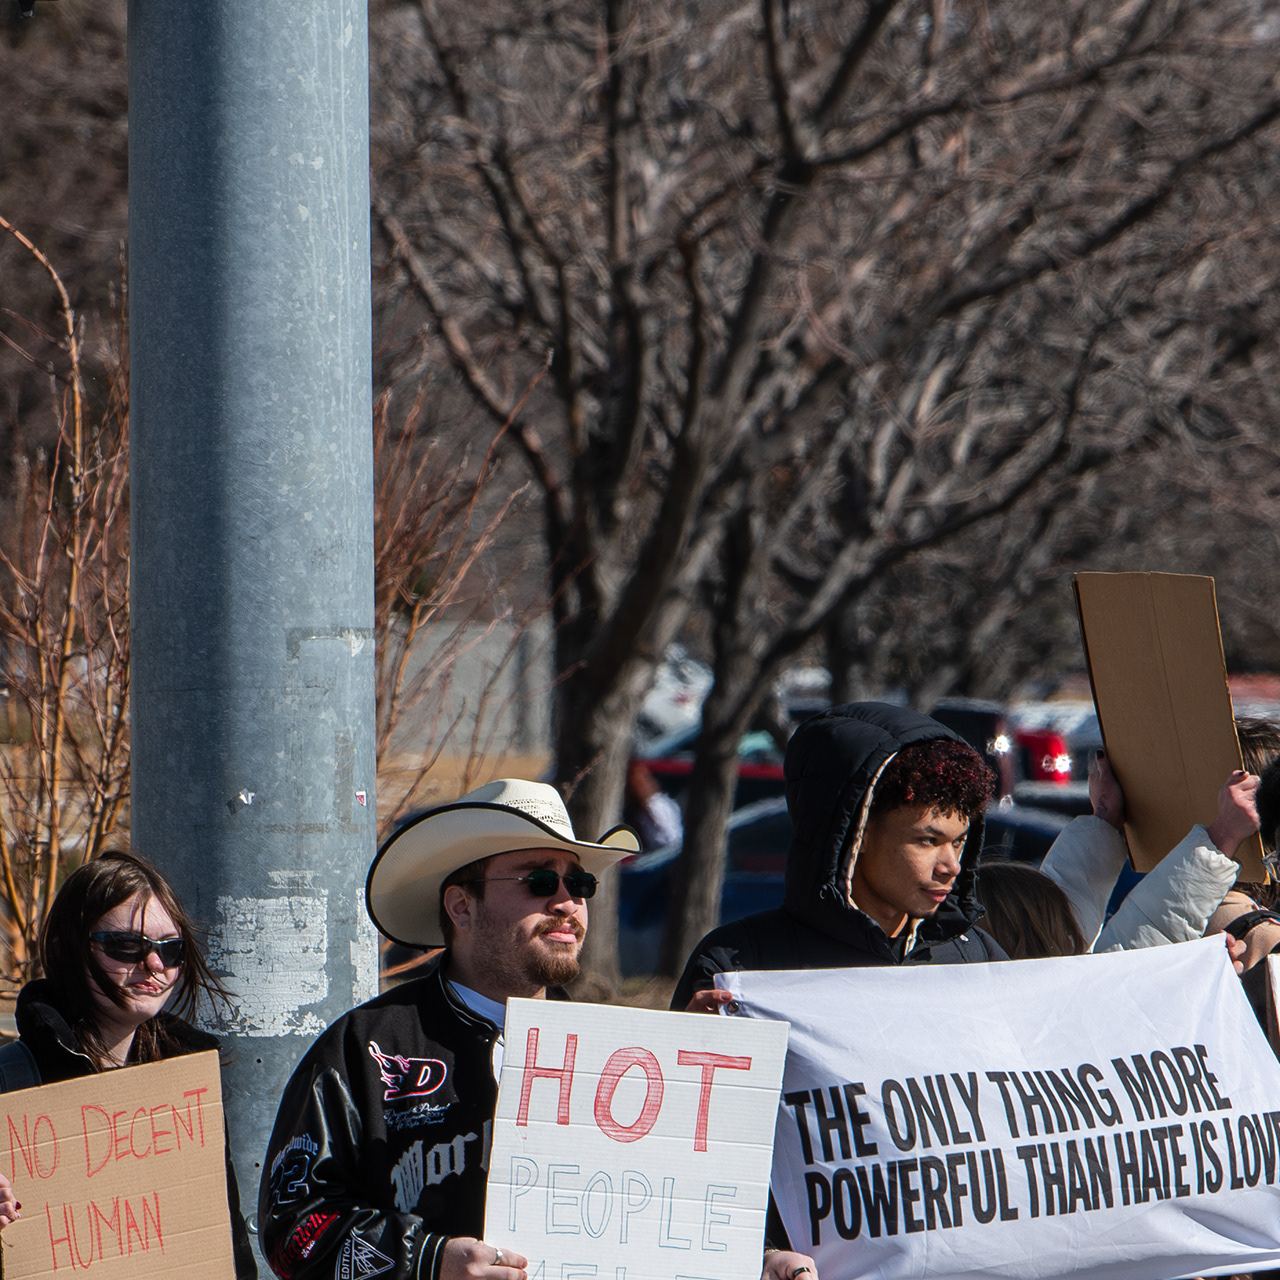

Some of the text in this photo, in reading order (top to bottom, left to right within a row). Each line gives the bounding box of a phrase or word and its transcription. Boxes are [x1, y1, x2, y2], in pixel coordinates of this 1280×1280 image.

[7, 1088, 209, 1180] NO DECENT
[516, 1028, 752, 1152] HOT
[784, 1045, 1233, 1165] THE ONLY THING MORE
[45, 1190, 166, 1272] HUMAN
[507, 1155, 737, 1252] PEOPLE
[805, 1149, 1019, 1246] POWERFUL
[1016, 1133, 1116, 1218] THAN
[1115, 1124, 1190, 1207] HATE
[1191, 1121, 1224, 1194] IS
[341, 1238, 351, 1280] EDITION
